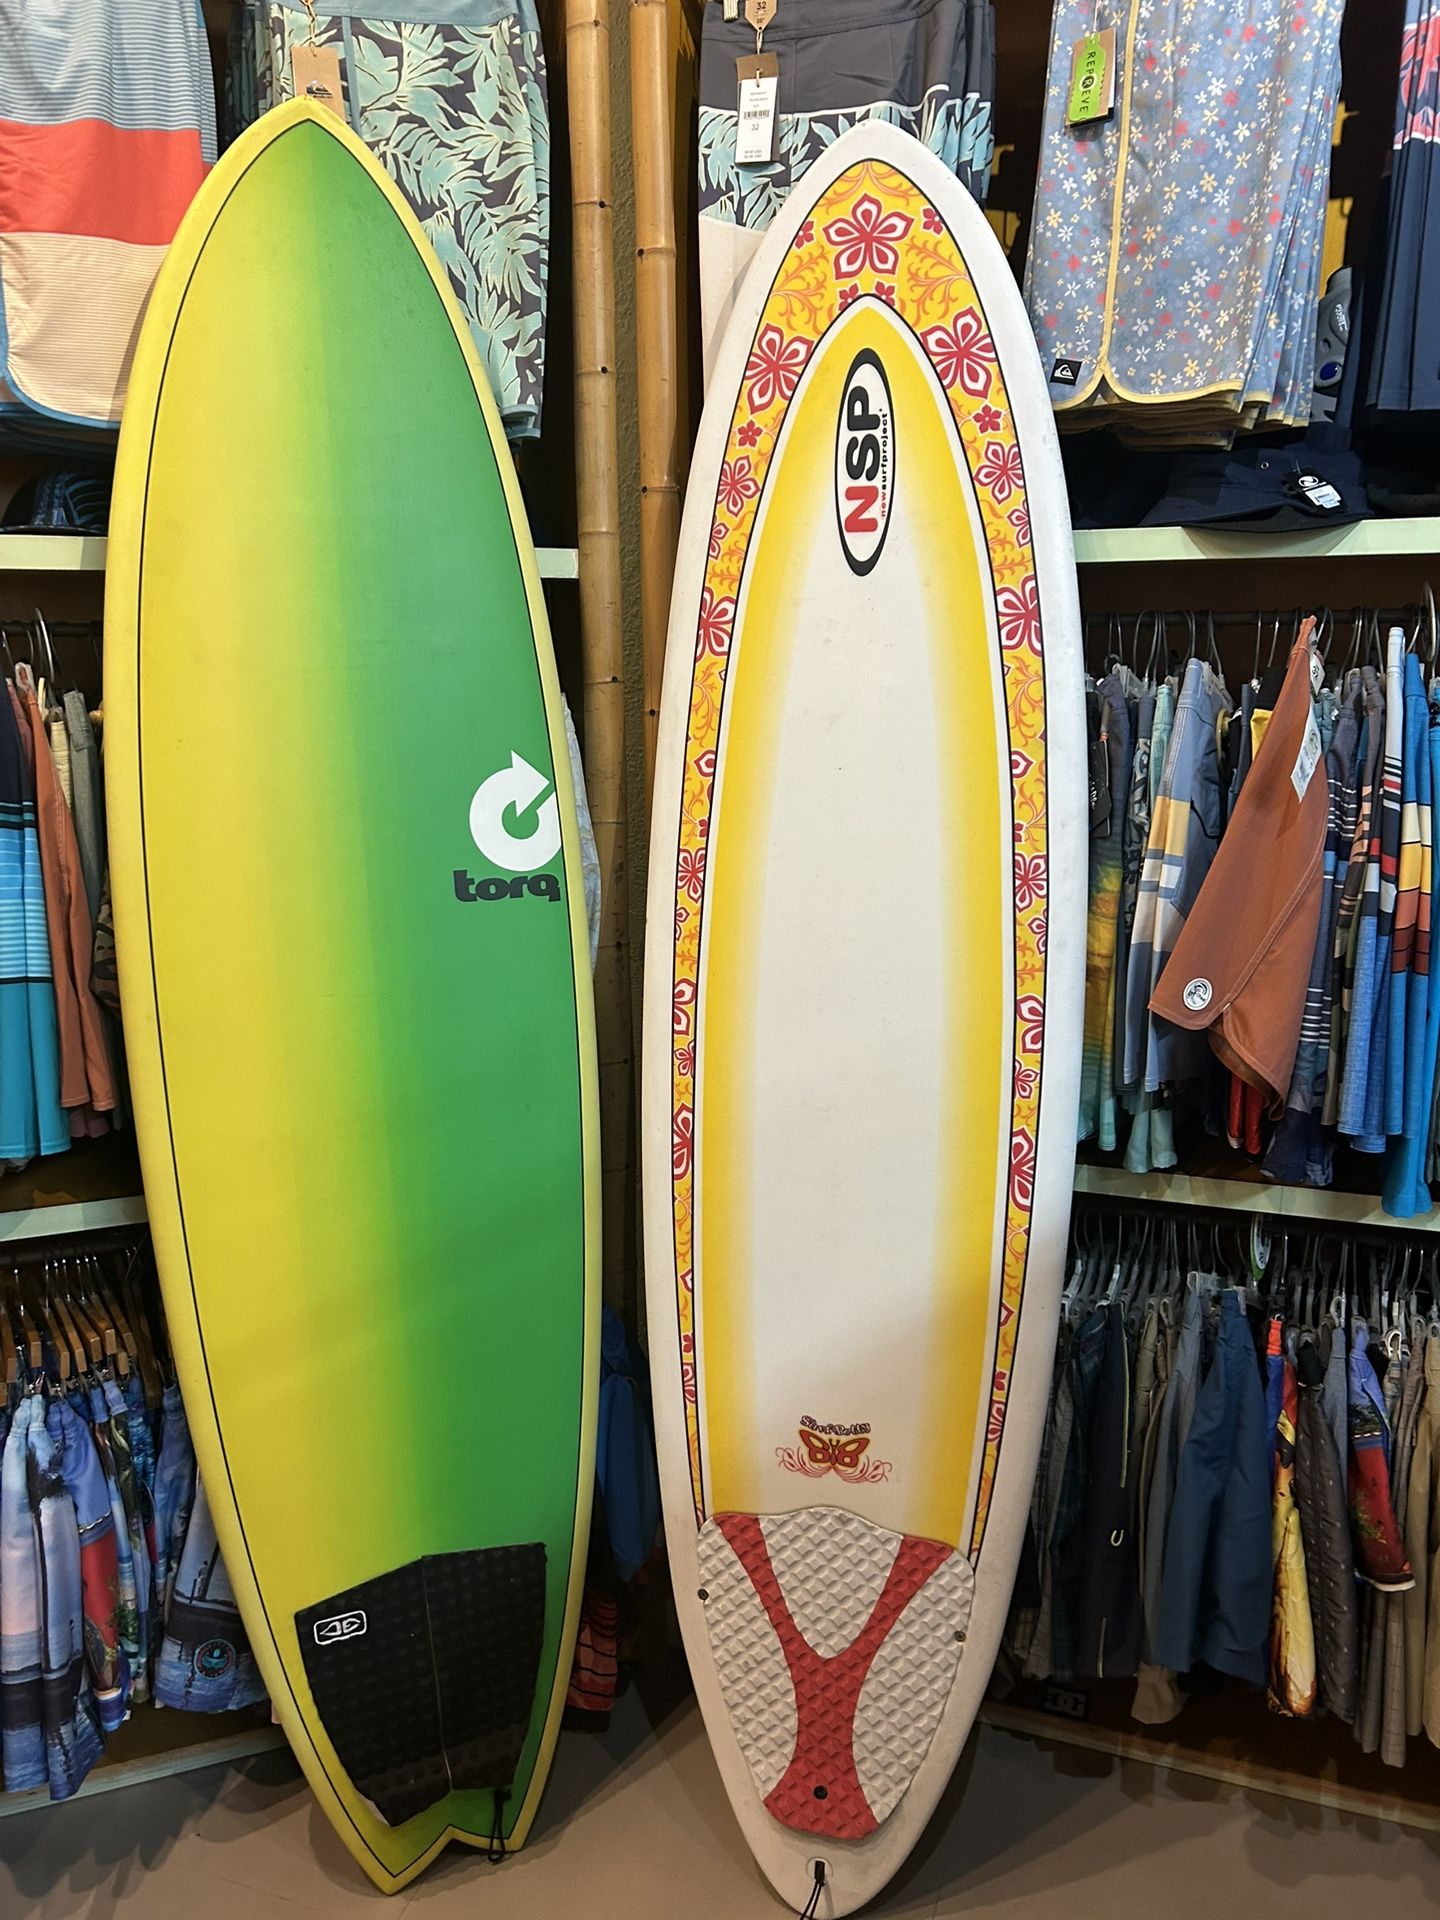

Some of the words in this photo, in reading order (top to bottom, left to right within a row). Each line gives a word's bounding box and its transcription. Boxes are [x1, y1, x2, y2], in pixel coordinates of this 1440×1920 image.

[756, 1, 767, 10] 32
[1079, 51, 1097, 113] REPREVE
[844, 385, 881, 533] NSP
[453, 869, 561, 902] torq
